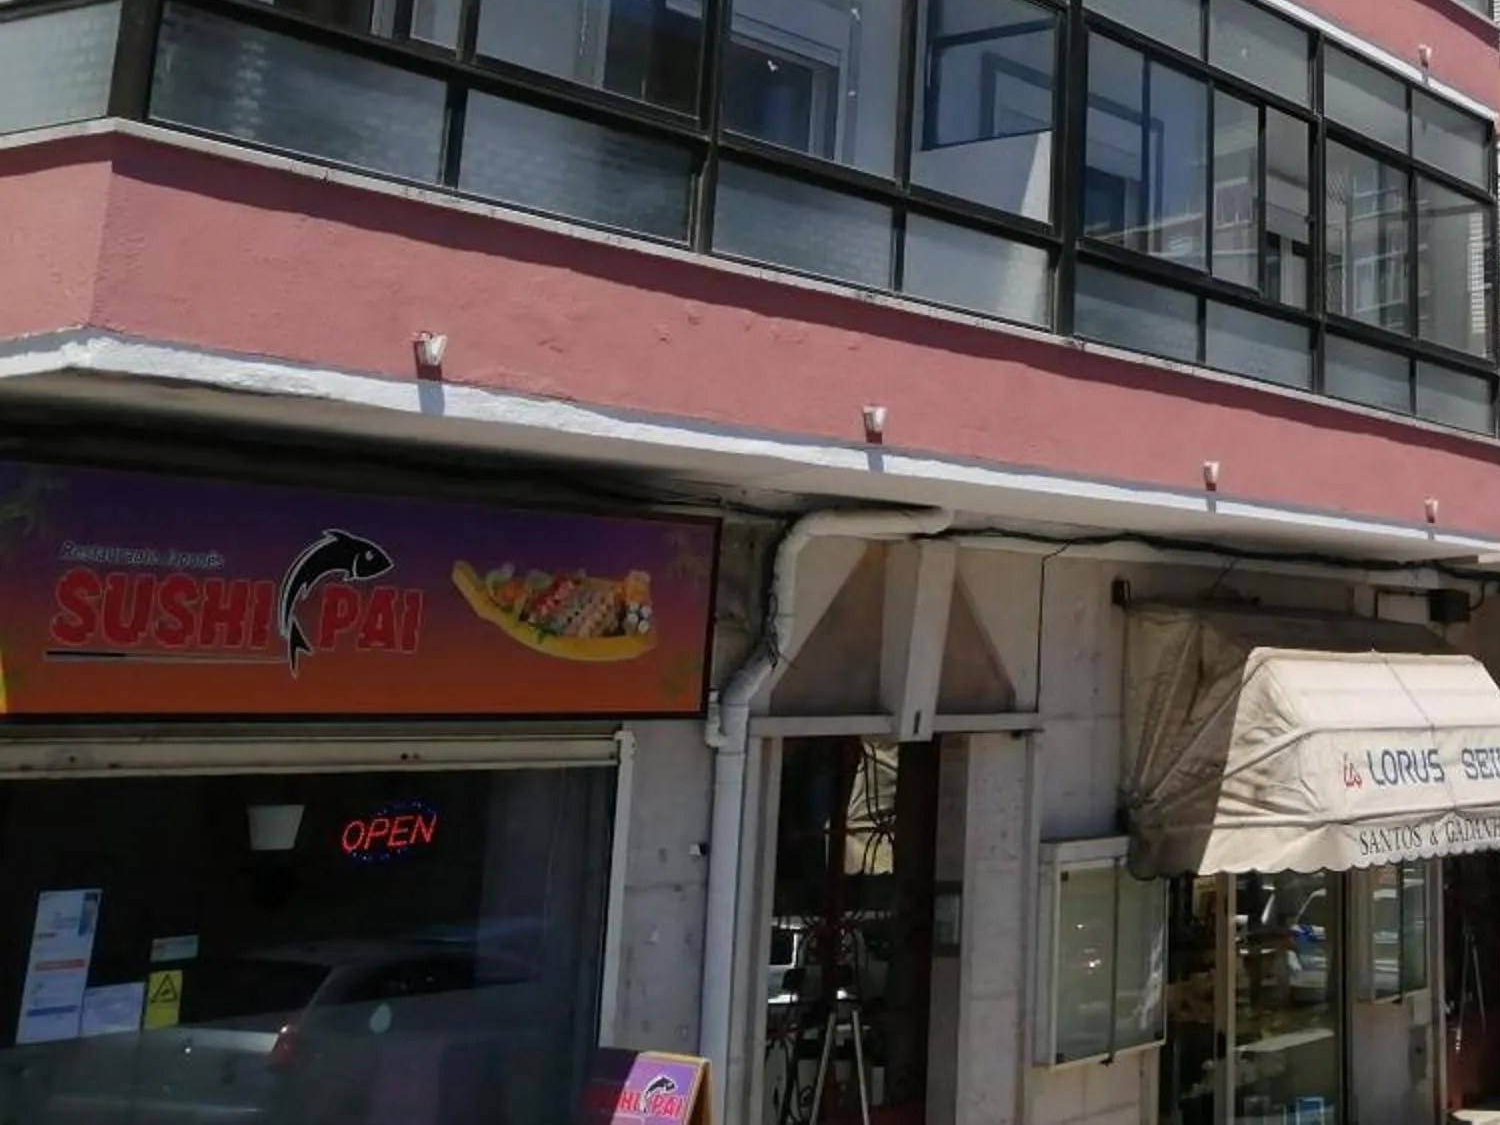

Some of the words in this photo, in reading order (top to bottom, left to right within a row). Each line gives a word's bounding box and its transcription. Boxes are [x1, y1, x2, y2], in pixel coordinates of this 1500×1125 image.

[52, 569, 275, 649] SUSHI
[318, 583, 424, 654] PAI
[1366, 748, 1446, 787] LORUS
[342, 812, 438, 853] OPEN
[1359, 824, 1423, 856] SANTOS
